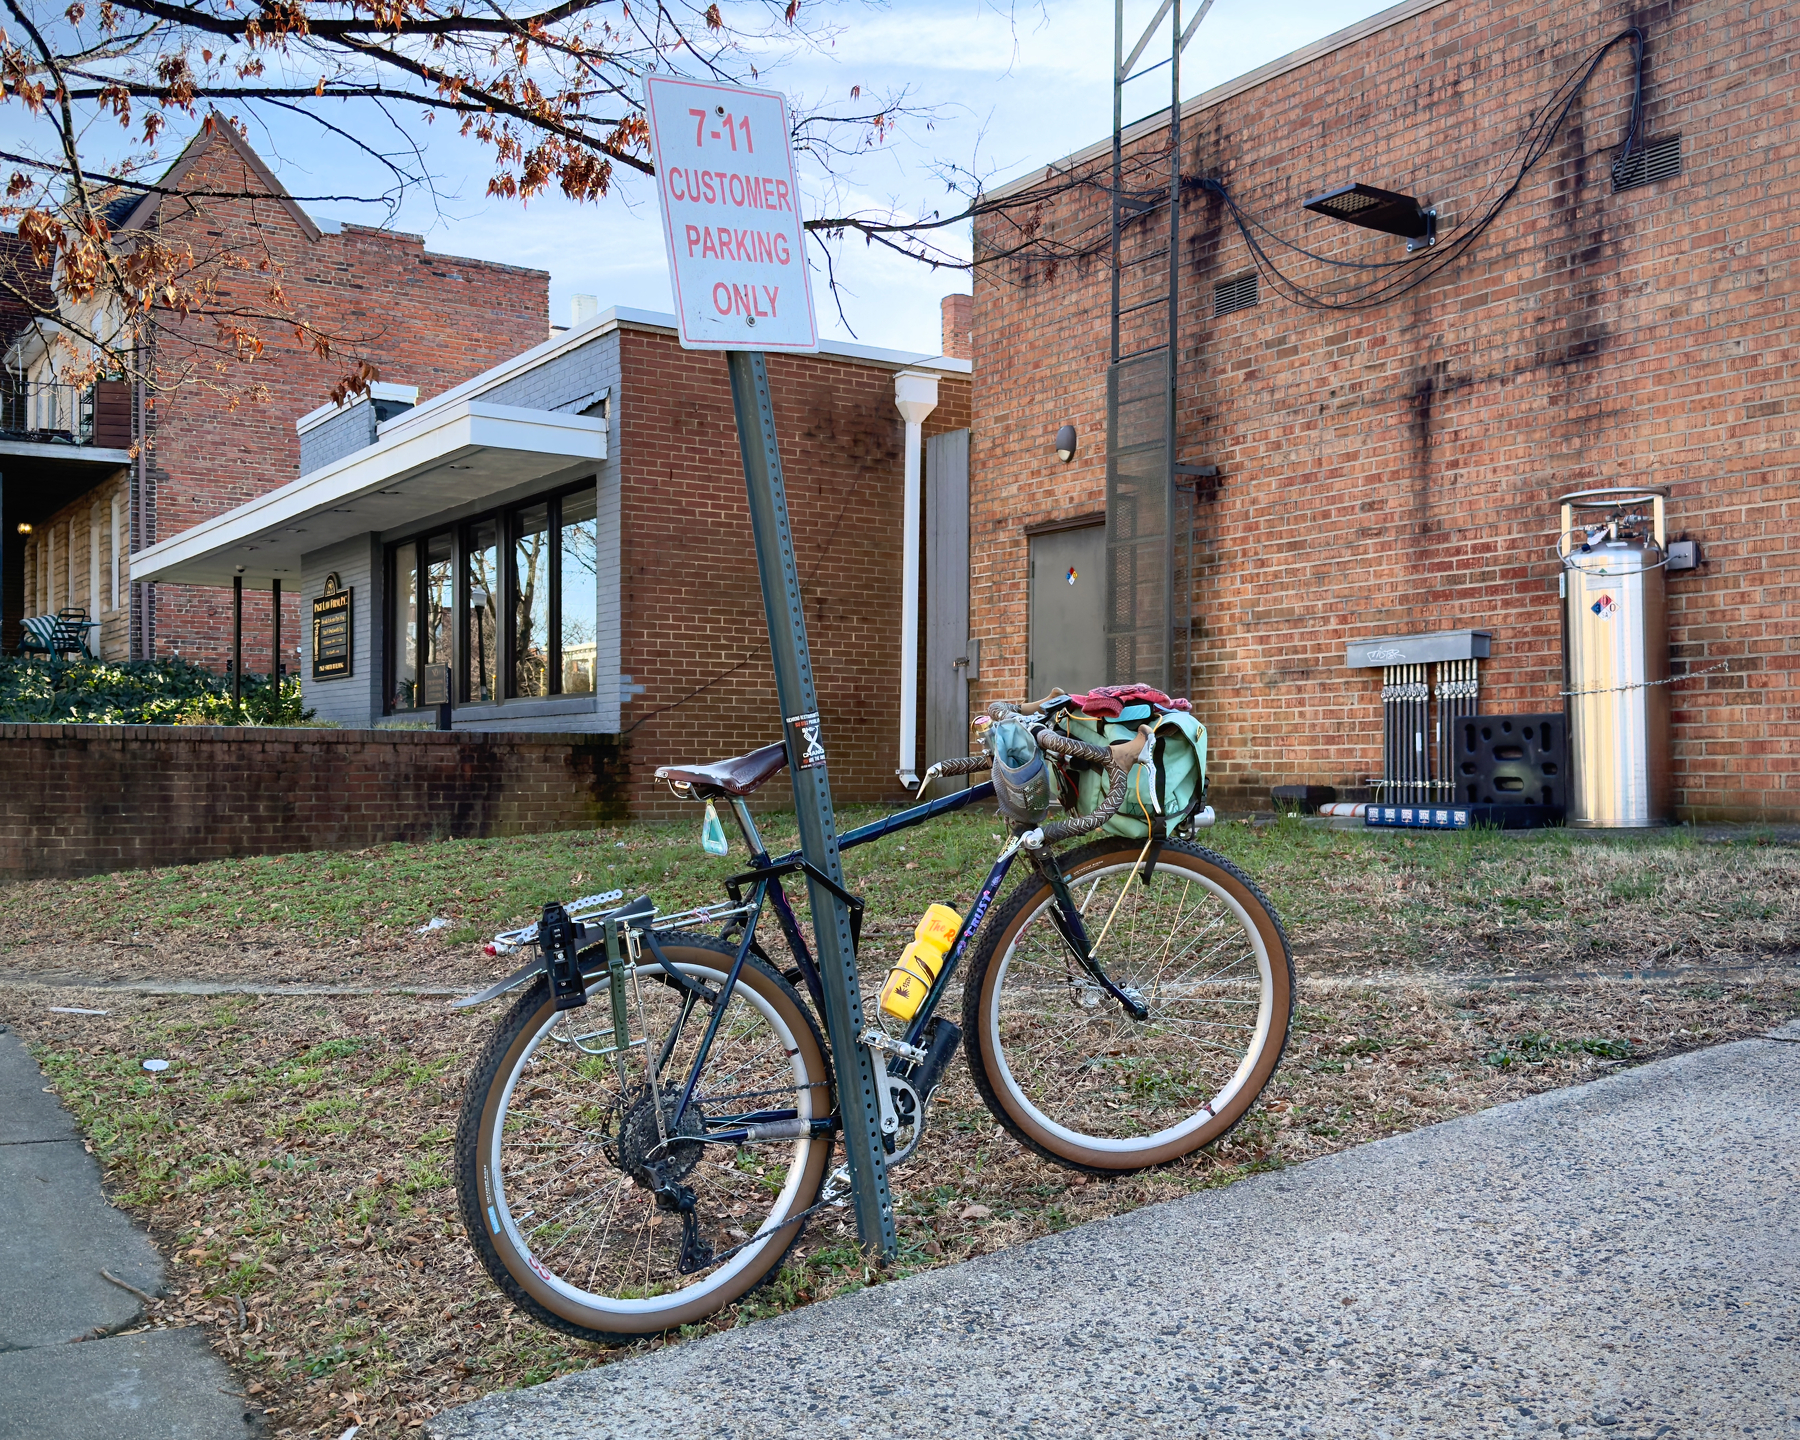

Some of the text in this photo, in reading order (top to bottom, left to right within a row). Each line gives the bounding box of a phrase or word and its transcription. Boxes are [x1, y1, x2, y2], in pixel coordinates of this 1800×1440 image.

[688, 108, 754, 154] 7-11
[668, 166, 793, 212] CUSTOMER
[685, 224, 791, 266] PARKING
[712, 282, 780, 318] ONLY
[966, 894, 991, 936] CRUST
